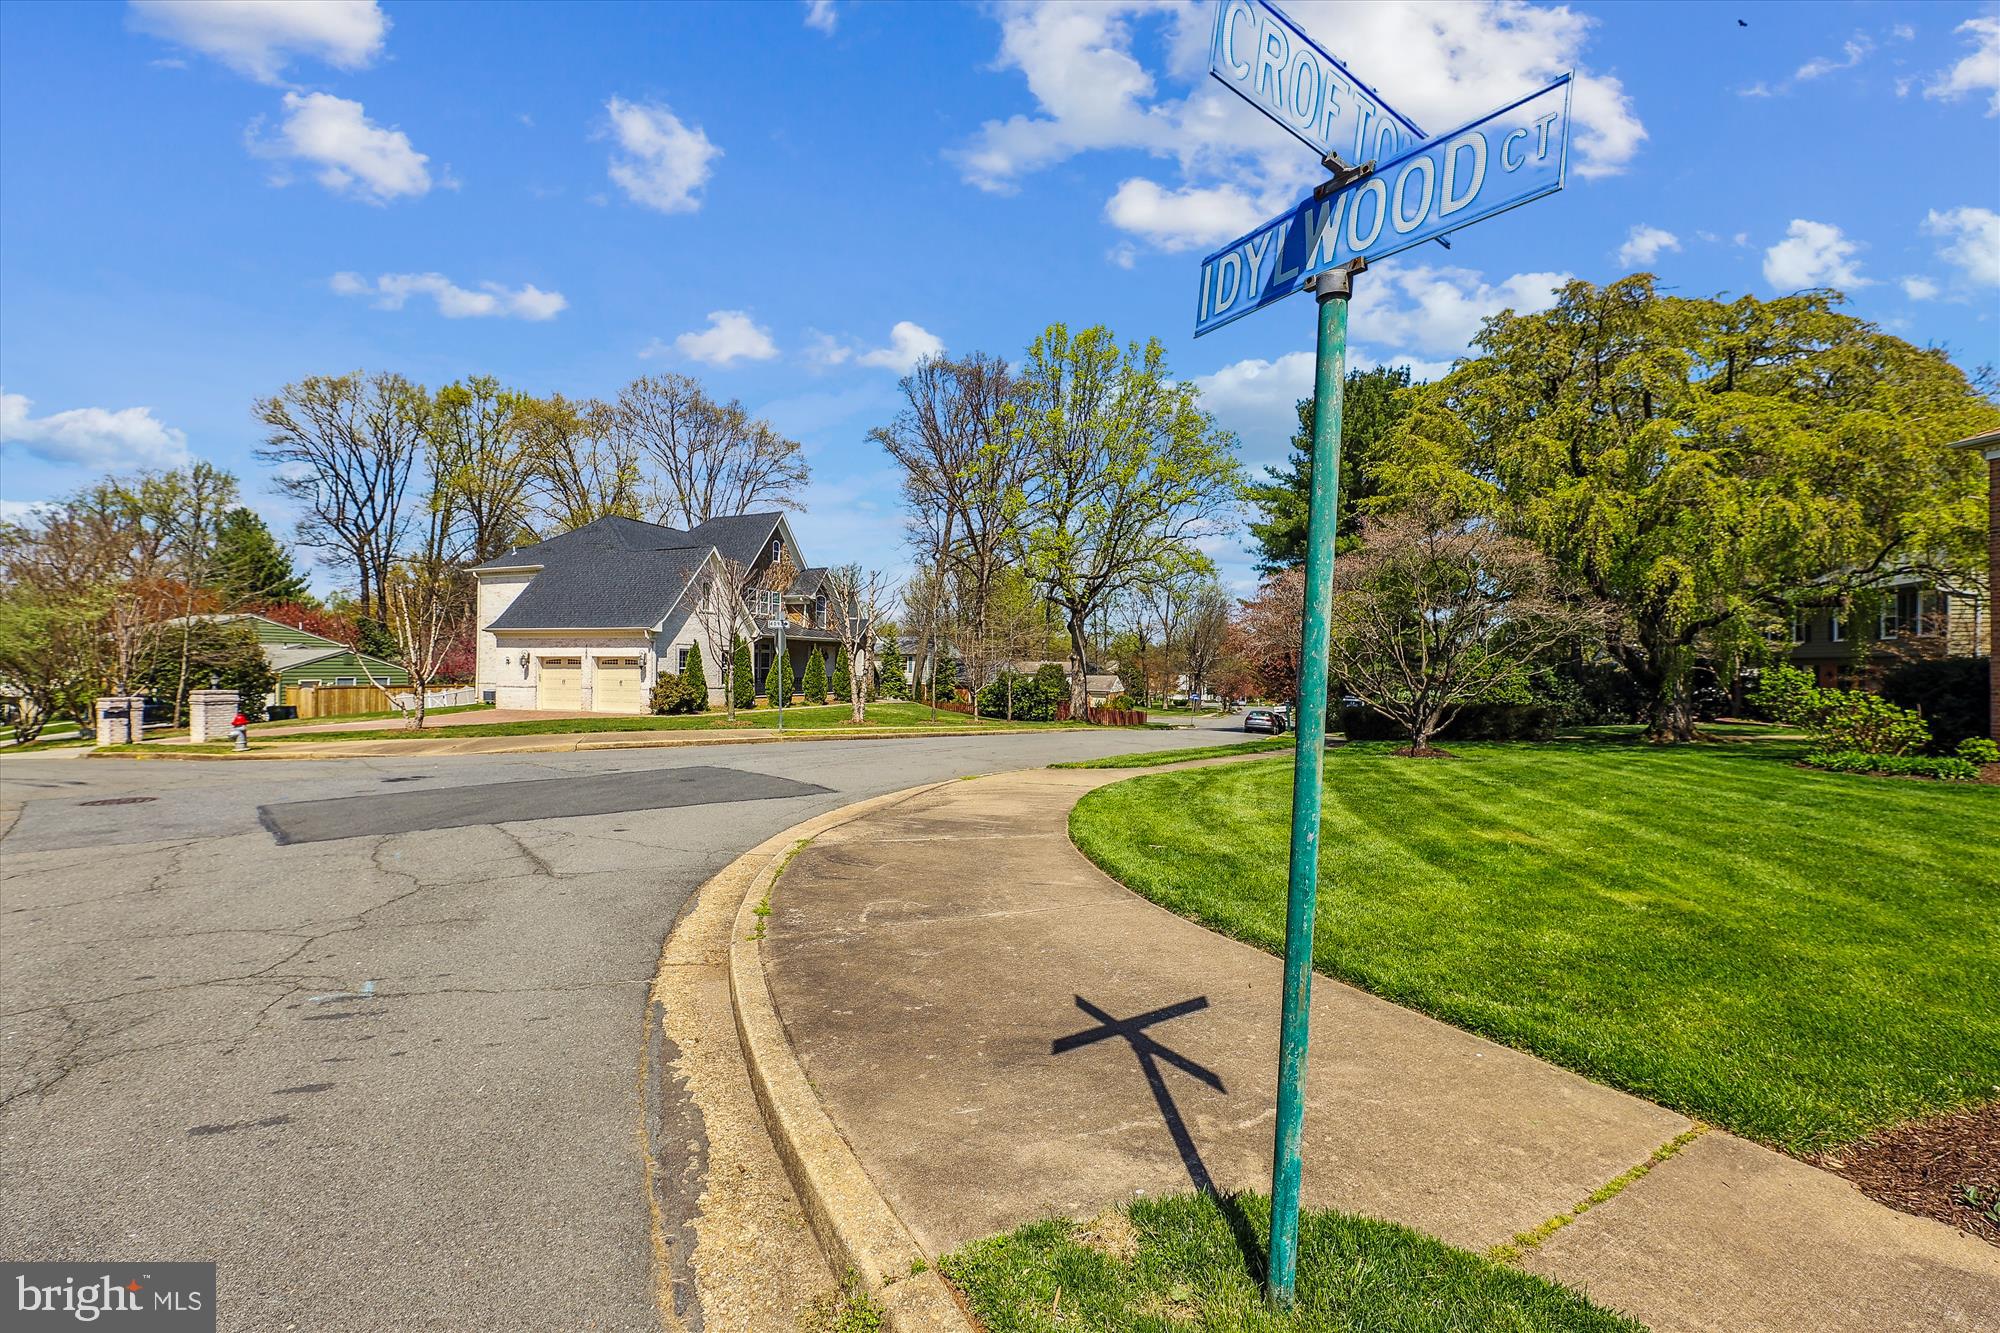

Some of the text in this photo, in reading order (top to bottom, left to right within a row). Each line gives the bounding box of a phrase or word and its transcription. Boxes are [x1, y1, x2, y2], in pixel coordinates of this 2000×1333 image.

[1223, 0, 1412, 168] CROFTO
[1200, 112, 1558, 322] IDYLWOOD CT
